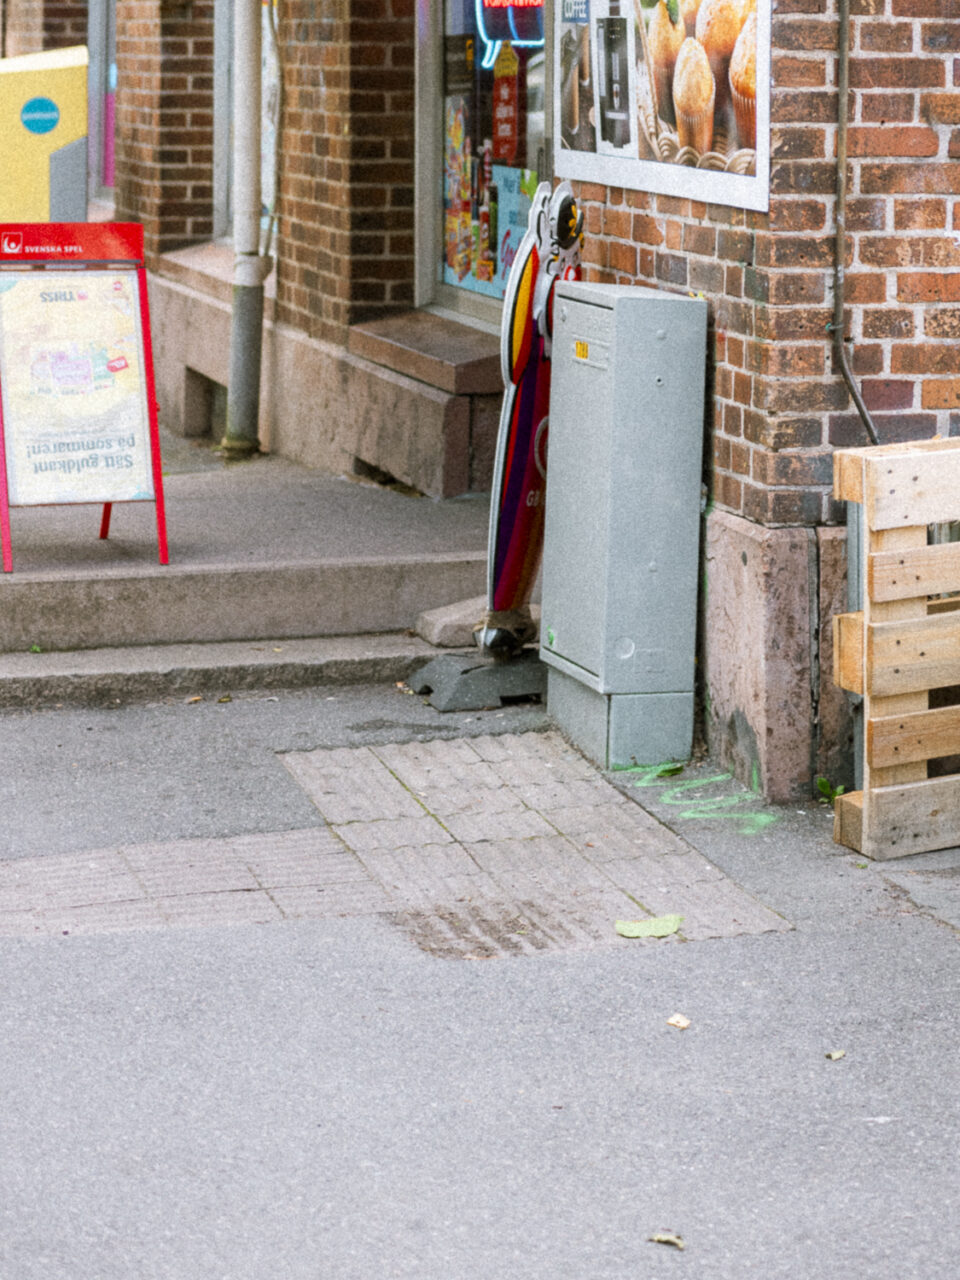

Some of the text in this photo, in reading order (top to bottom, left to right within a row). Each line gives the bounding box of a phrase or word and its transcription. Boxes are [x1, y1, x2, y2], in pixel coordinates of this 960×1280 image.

[24, 244, 84, 253] SVENSKA SPEL
[26, 438, 113, 458] sommaren!
[33, 453, 99, 474] guldkant
